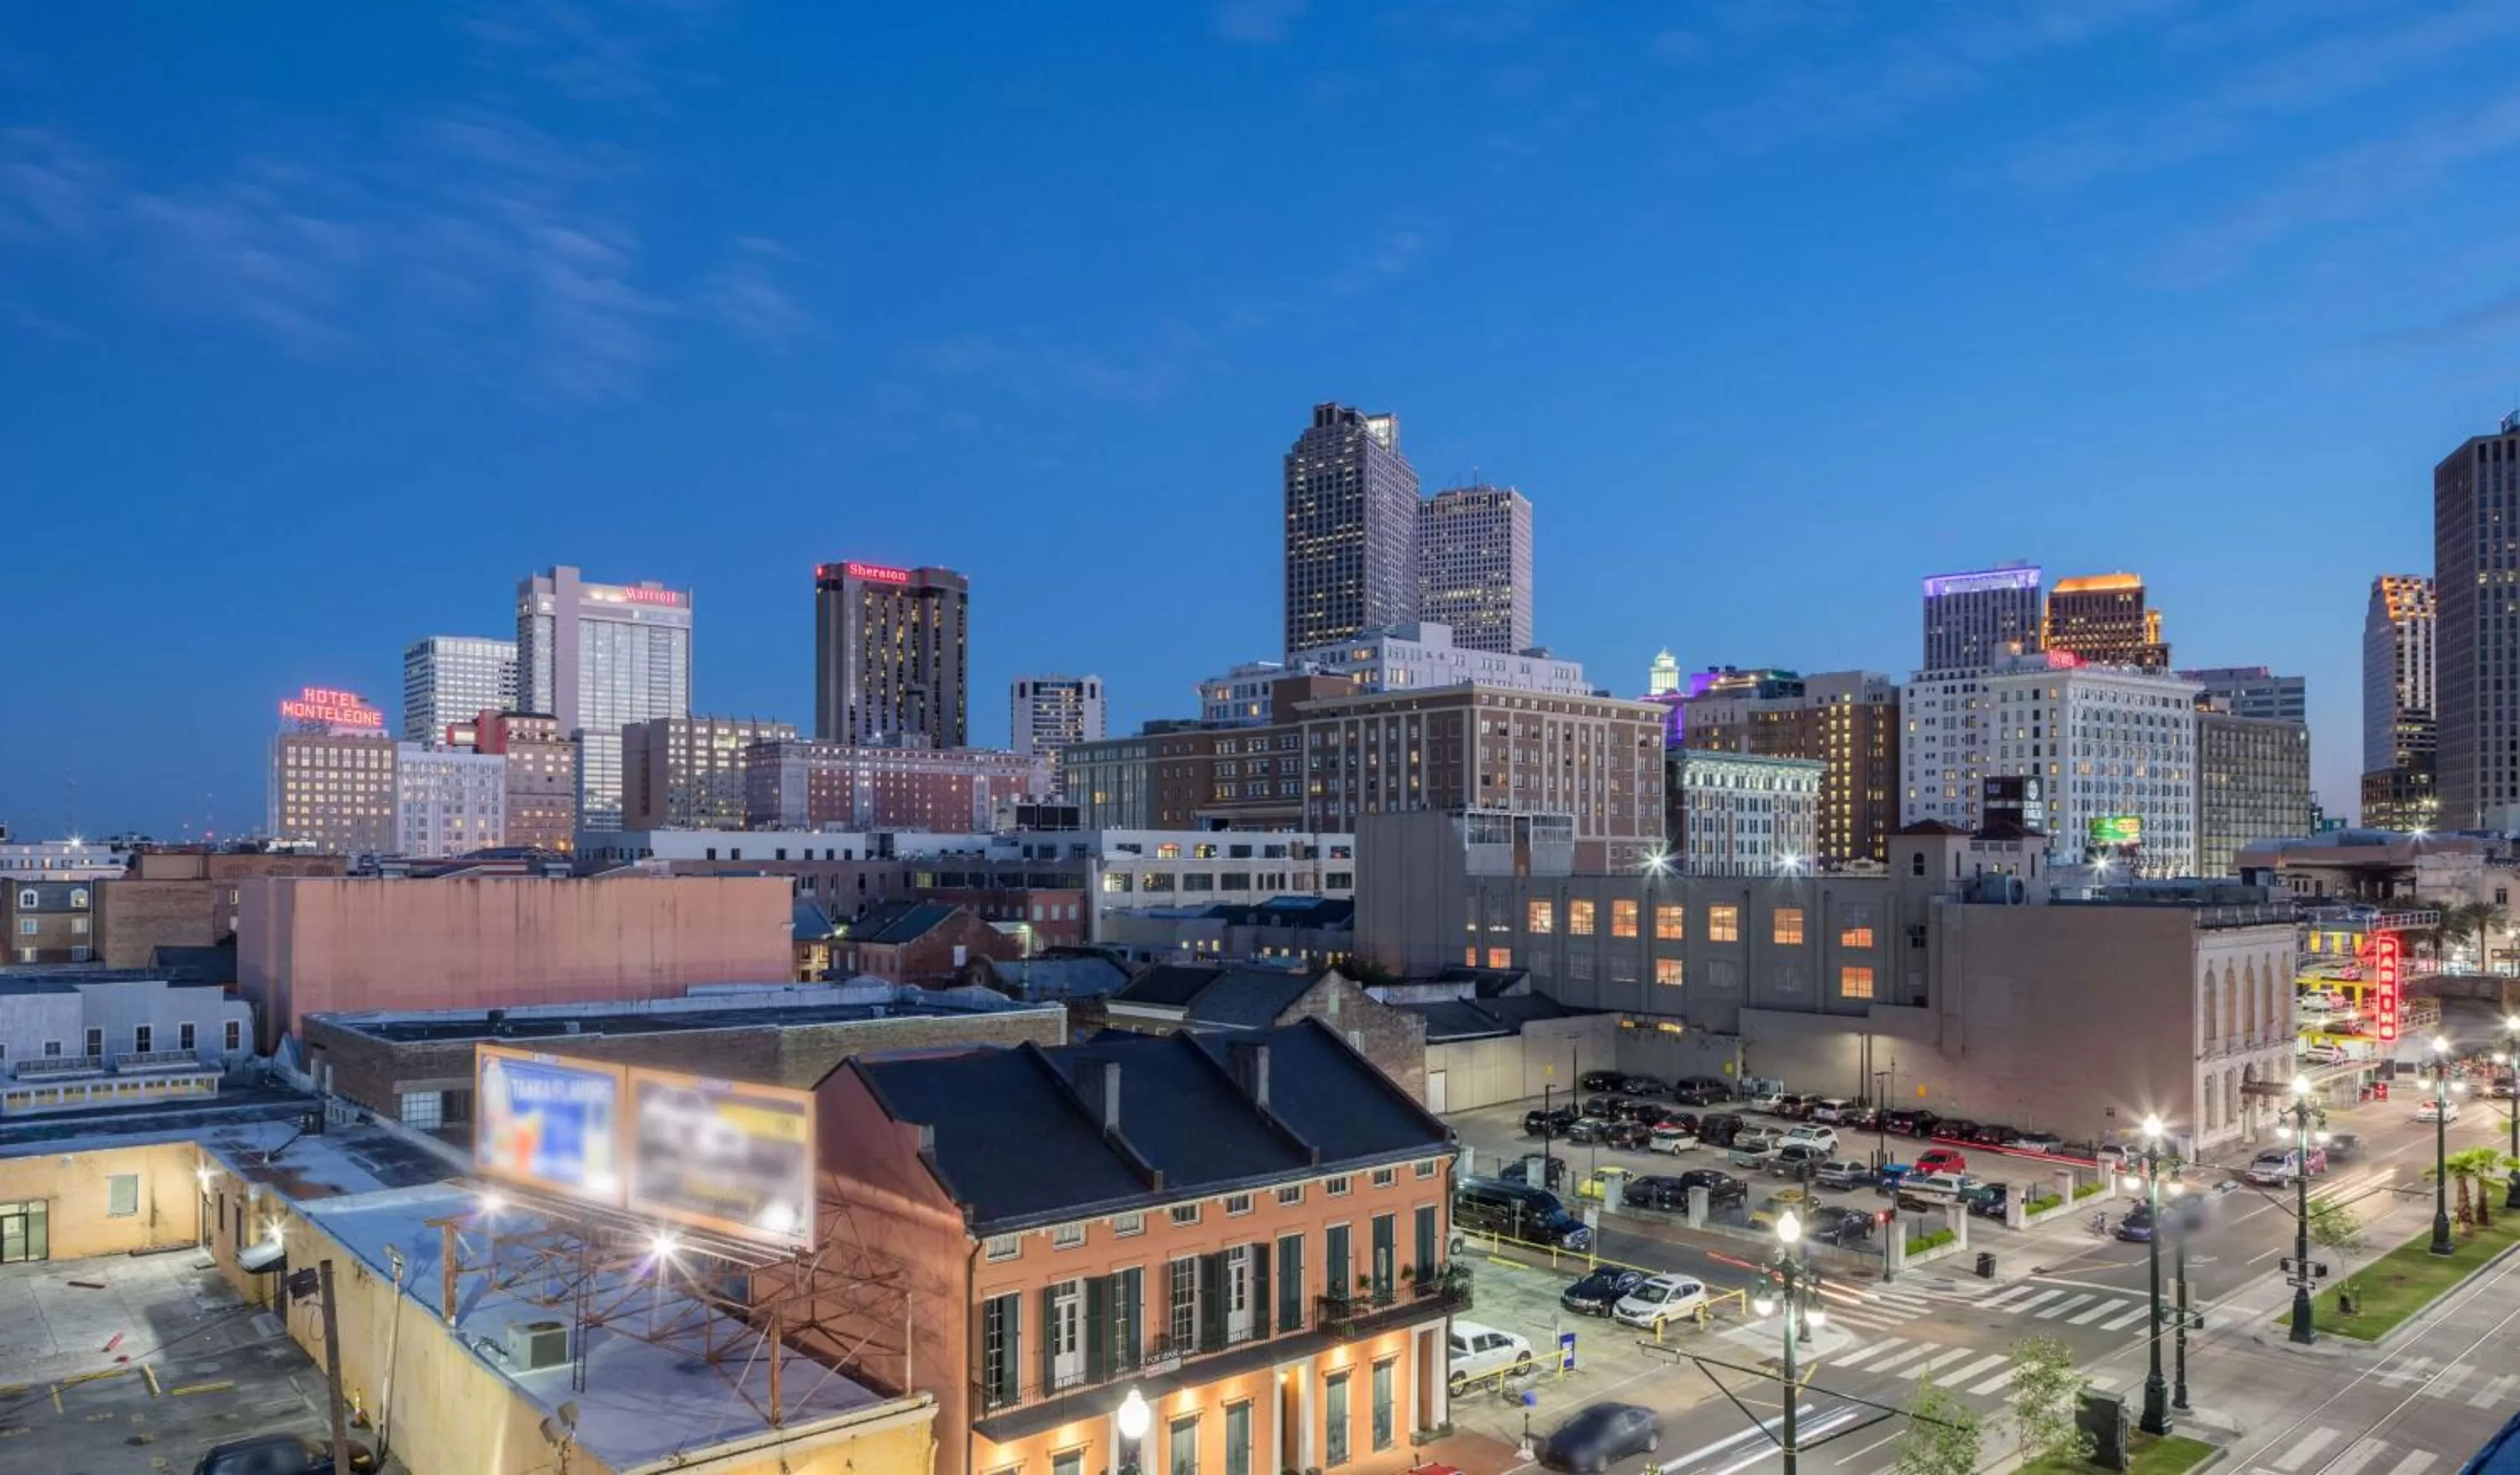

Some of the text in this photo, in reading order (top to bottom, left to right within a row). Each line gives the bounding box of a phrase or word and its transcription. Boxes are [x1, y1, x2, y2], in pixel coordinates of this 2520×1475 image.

[849, 564, 907, 581] Sheraton
[624, 587, 676, 603] Marriott
[303, 687, 361, 708] HOTEL
[281, 701, 383, 726] MONTELEONE
[2380, 942, 2394, 1037] PARKING
